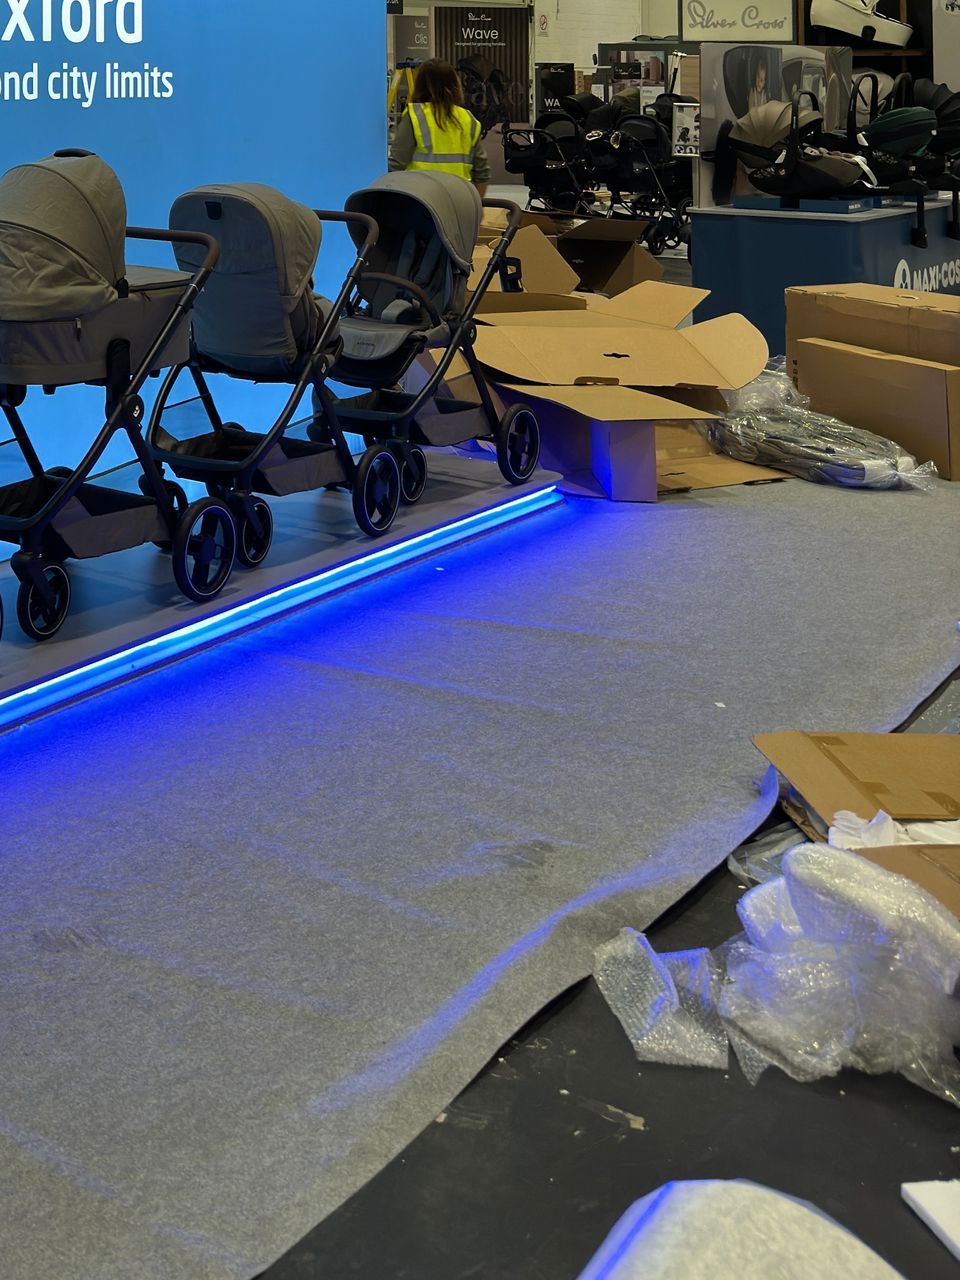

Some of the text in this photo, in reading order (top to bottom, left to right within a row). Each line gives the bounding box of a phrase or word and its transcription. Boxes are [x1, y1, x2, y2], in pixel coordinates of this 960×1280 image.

[687, 0, 785, 29] Silver Cross
[461, 27, 499, 40] Wave
[47, 62, 97, 108] city
[105, 62, 174, 99] limits
[544, 98, 561, 107] WA
